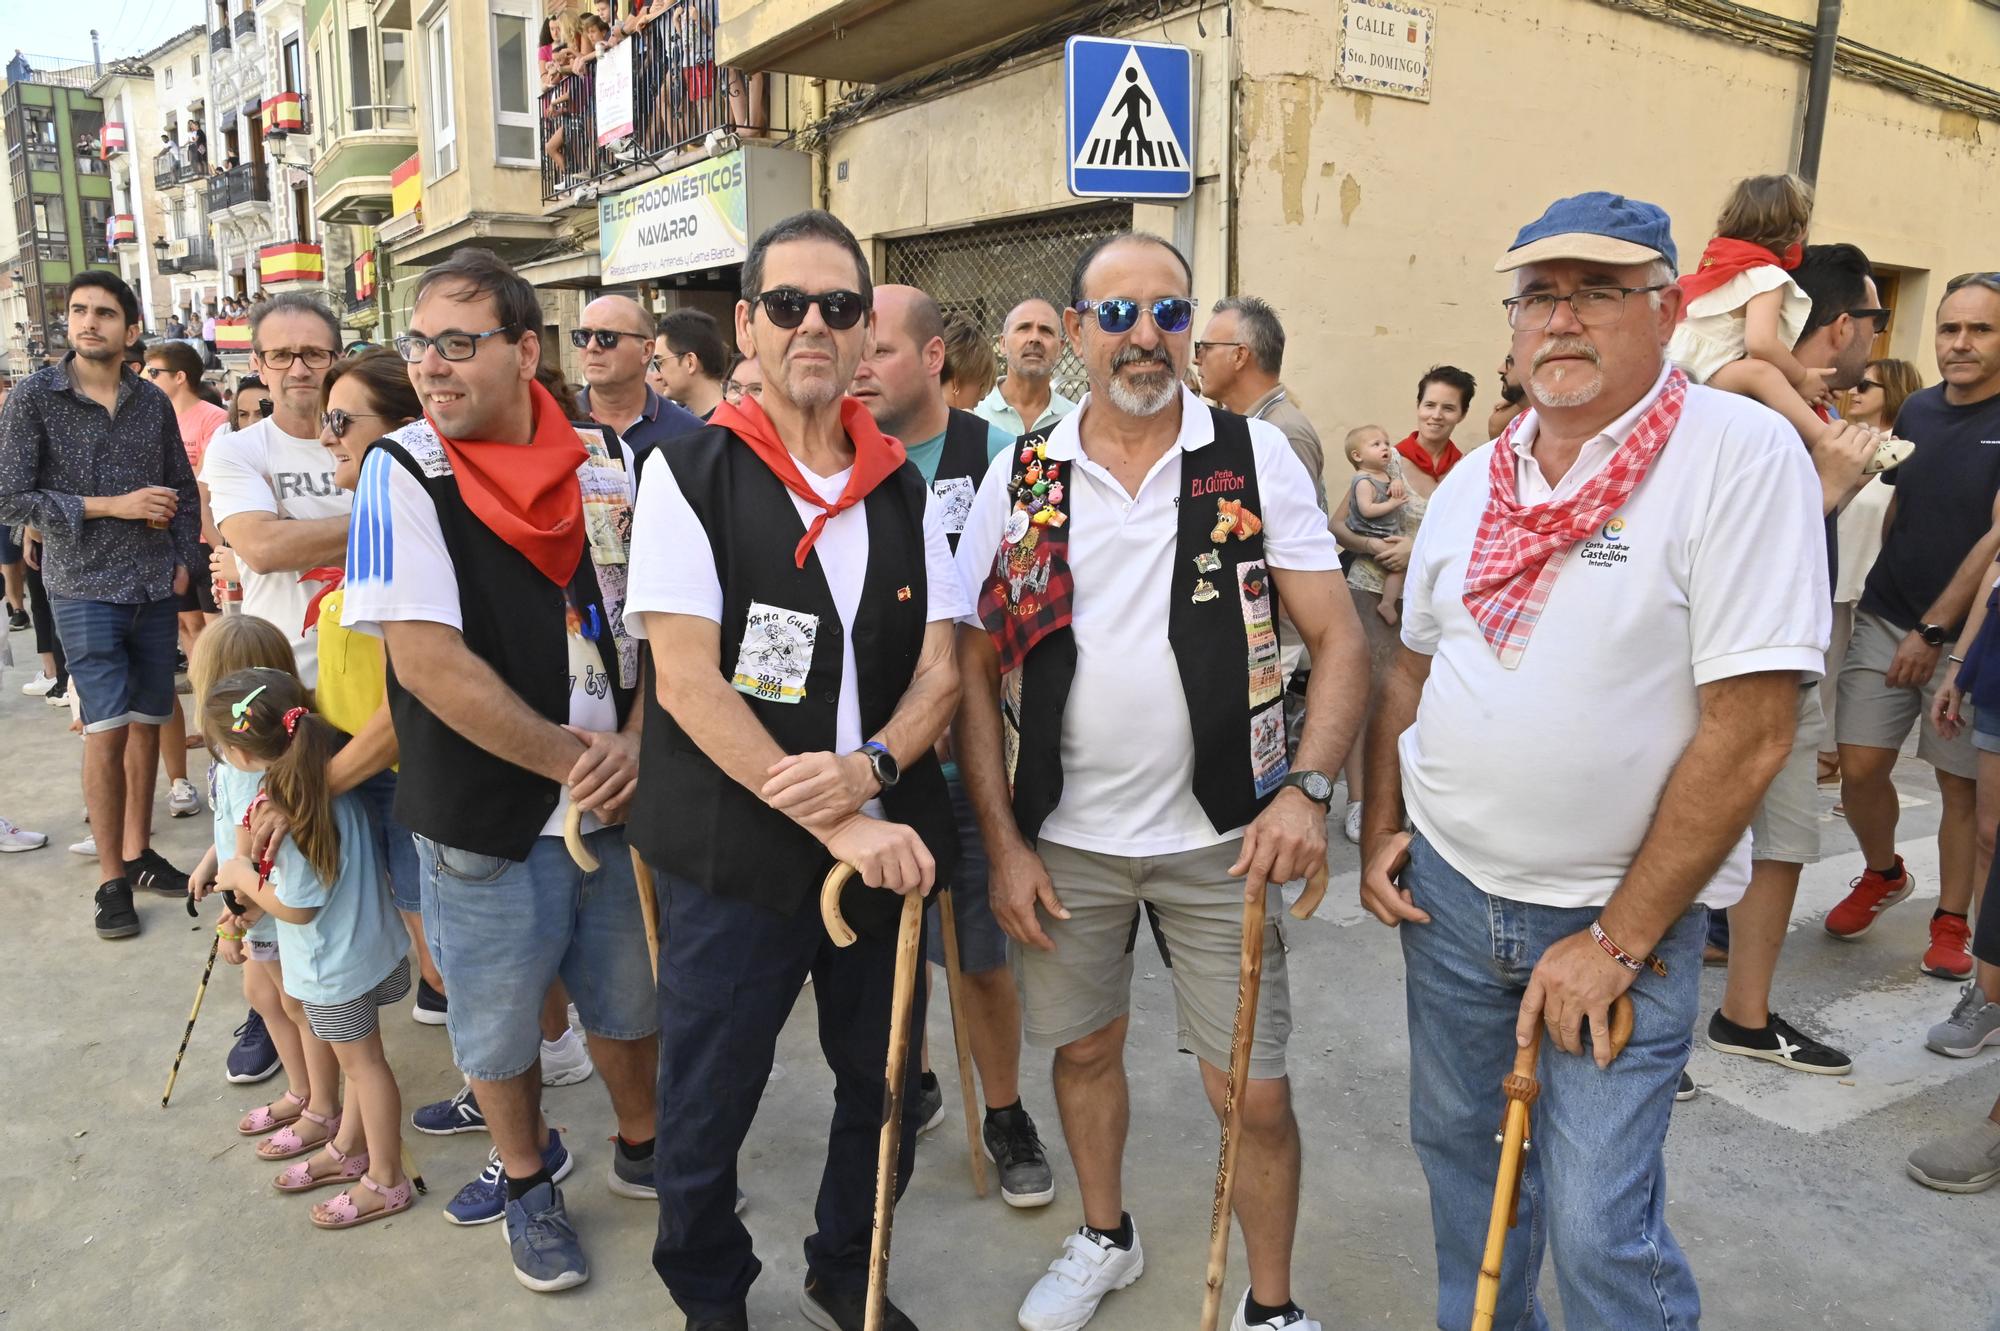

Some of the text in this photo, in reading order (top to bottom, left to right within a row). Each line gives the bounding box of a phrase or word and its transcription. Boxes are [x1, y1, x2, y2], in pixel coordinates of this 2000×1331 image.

[1356, 16, 1395, 37] CALLE
[1348, 48, 1421, 74] Sto. DOMINGO
[604, 161, 742, 223] ELECTRODOMÉSTICOS
[638, 214, 698, 248] NAVARRO
[1215, 469, 1233, 479] Peña
[1192, 479, 1205, 497] EL
[1585, 541, 1630, 551] Costa Azahar
[1581, 549, 1628, 563] Castellón
[757, 672, 783, 685] 2022
[758, 680, 783, 692] 2021
[755, 689, 781, 700] 2020
